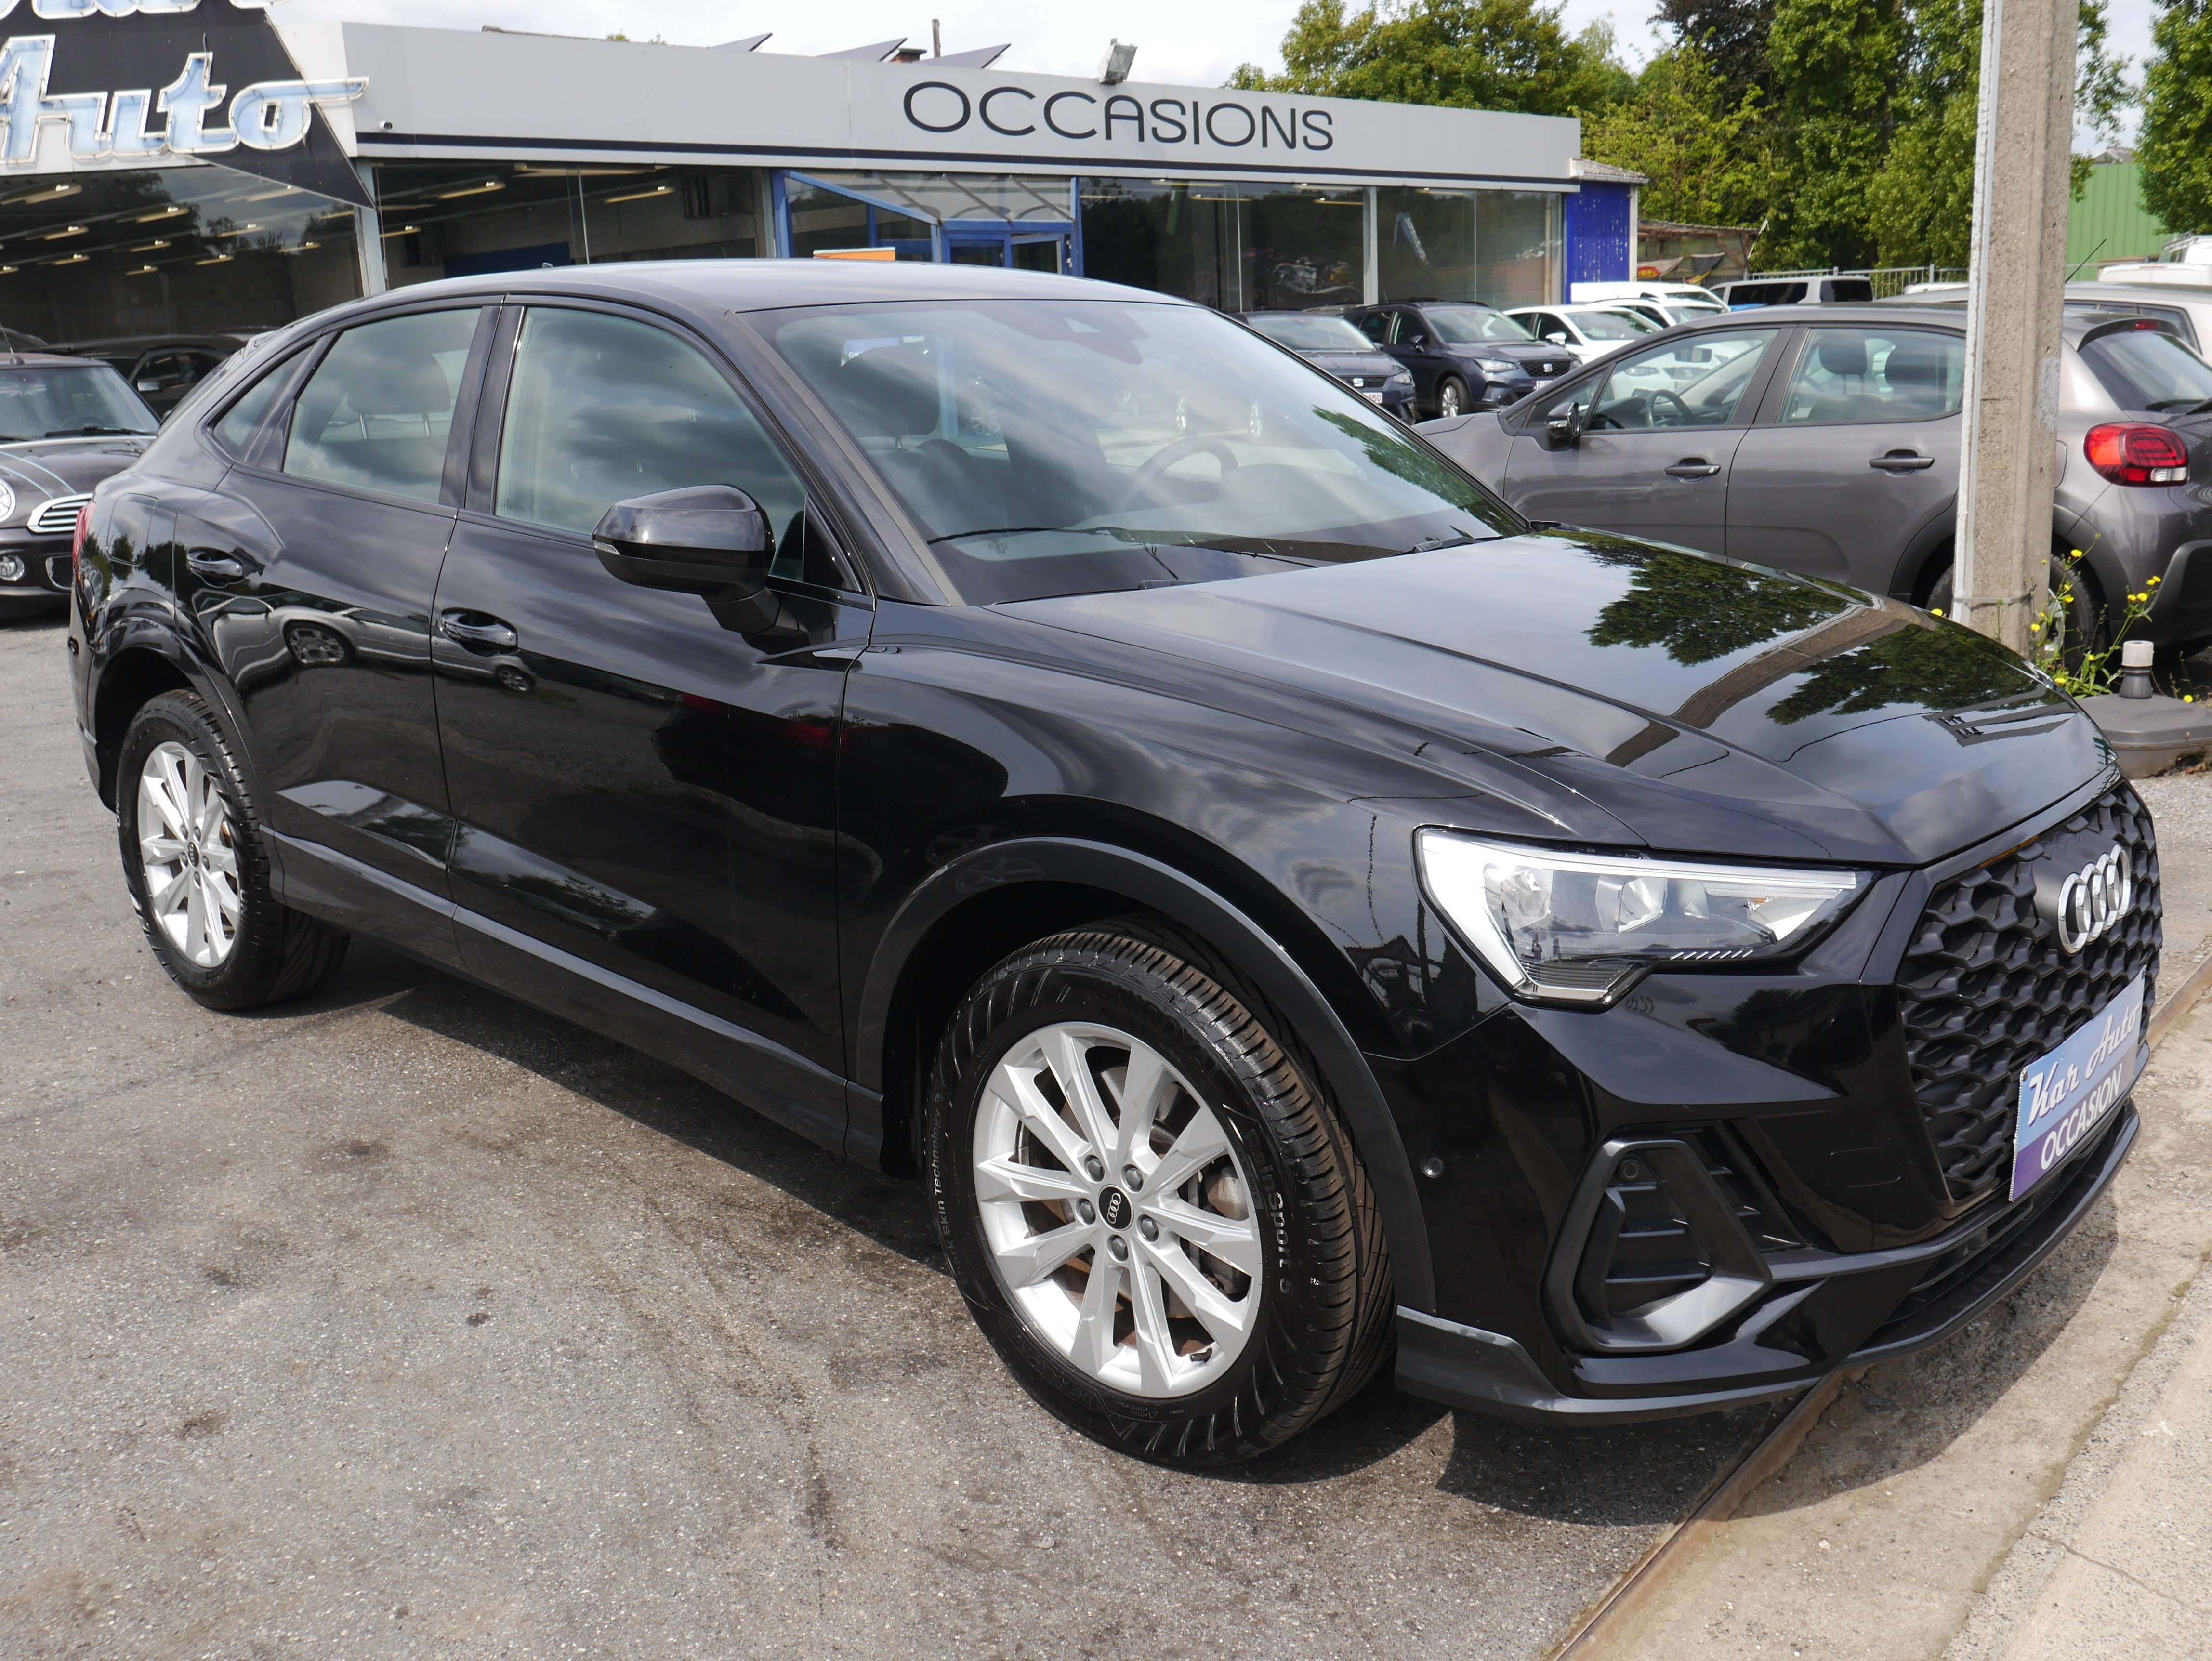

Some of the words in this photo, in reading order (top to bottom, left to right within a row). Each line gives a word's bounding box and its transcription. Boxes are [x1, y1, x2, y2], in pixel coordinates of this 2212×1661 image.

[0, 34, 369, 165] Auto
[903, 81, 1333, 150] OCCASIONS
[2028, 1061, 2080, 1126] Kar
[2086, 1005, 2139, 1079] Auto
[931, 1107, 943, 1196] Technology
[2041, 1063, 2122, 1170] OCCASION
[938, 1200, 950, 1236] Skin
